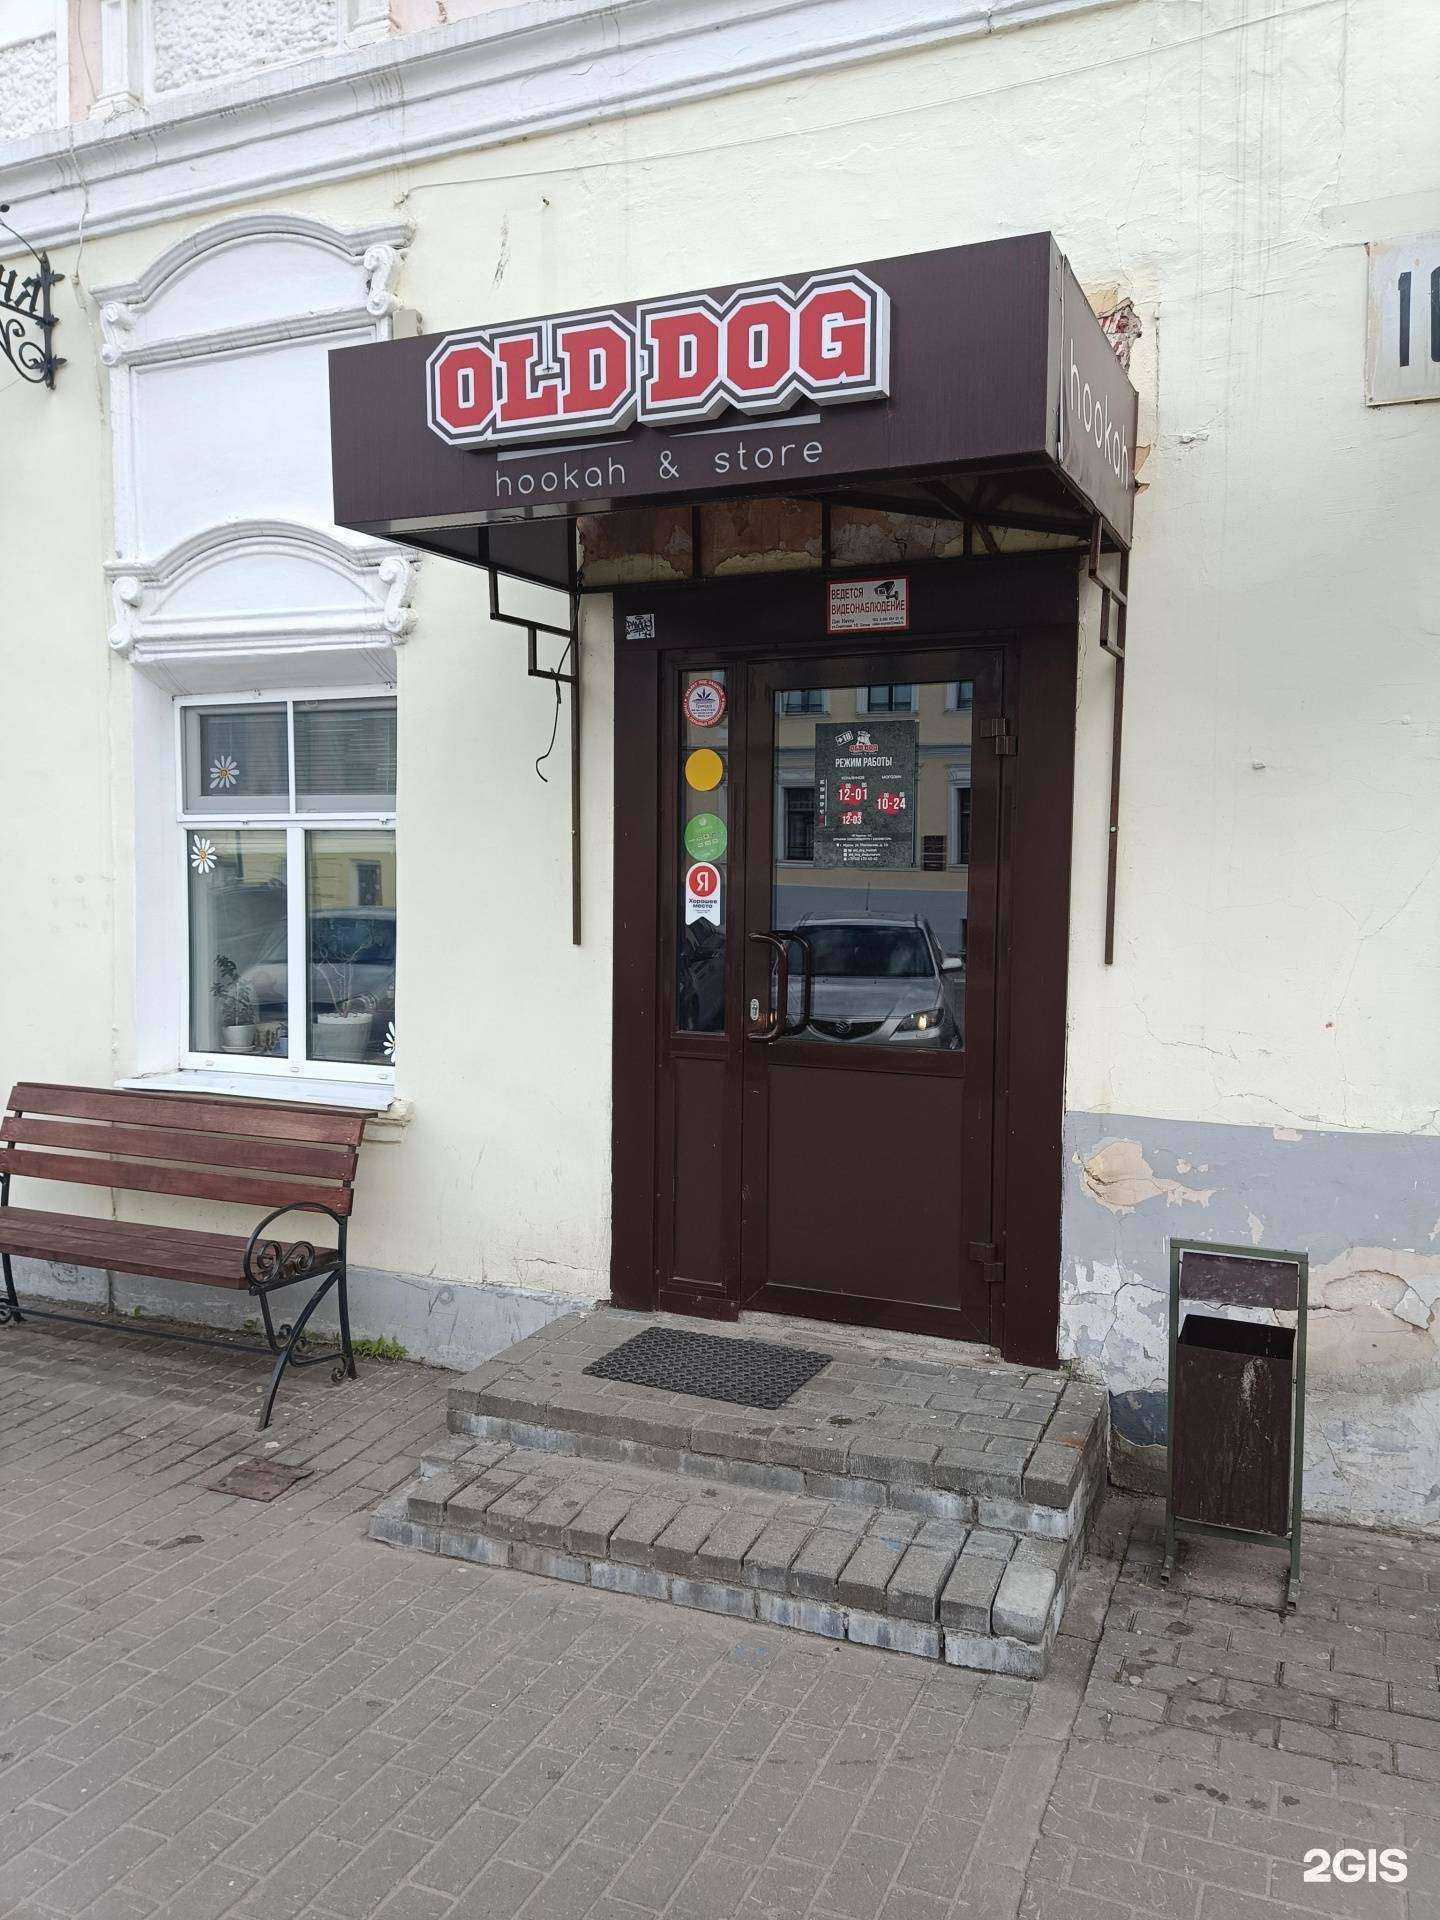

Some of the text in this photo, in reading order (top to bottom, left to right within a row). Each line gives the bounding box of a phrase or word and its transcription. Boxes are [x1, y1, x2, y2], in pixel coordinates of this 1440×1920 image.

[432, 278, 874, 438] OLD DOG
[1070, 338, 1129, 490] hookah
[495, 439, 824, 497] hookah & store
[831, 587, 863, 601] ВЕДЕТСЯ
[831, 601, 905, 615] ВИДЕОНАБЛЮДЕНИЕ
[835, 756, 893, 768] РЕЖИМ РАБОТЫ
[838, 788, 868, 801] 12-01
[877, 797, 906, 810] 10-24
